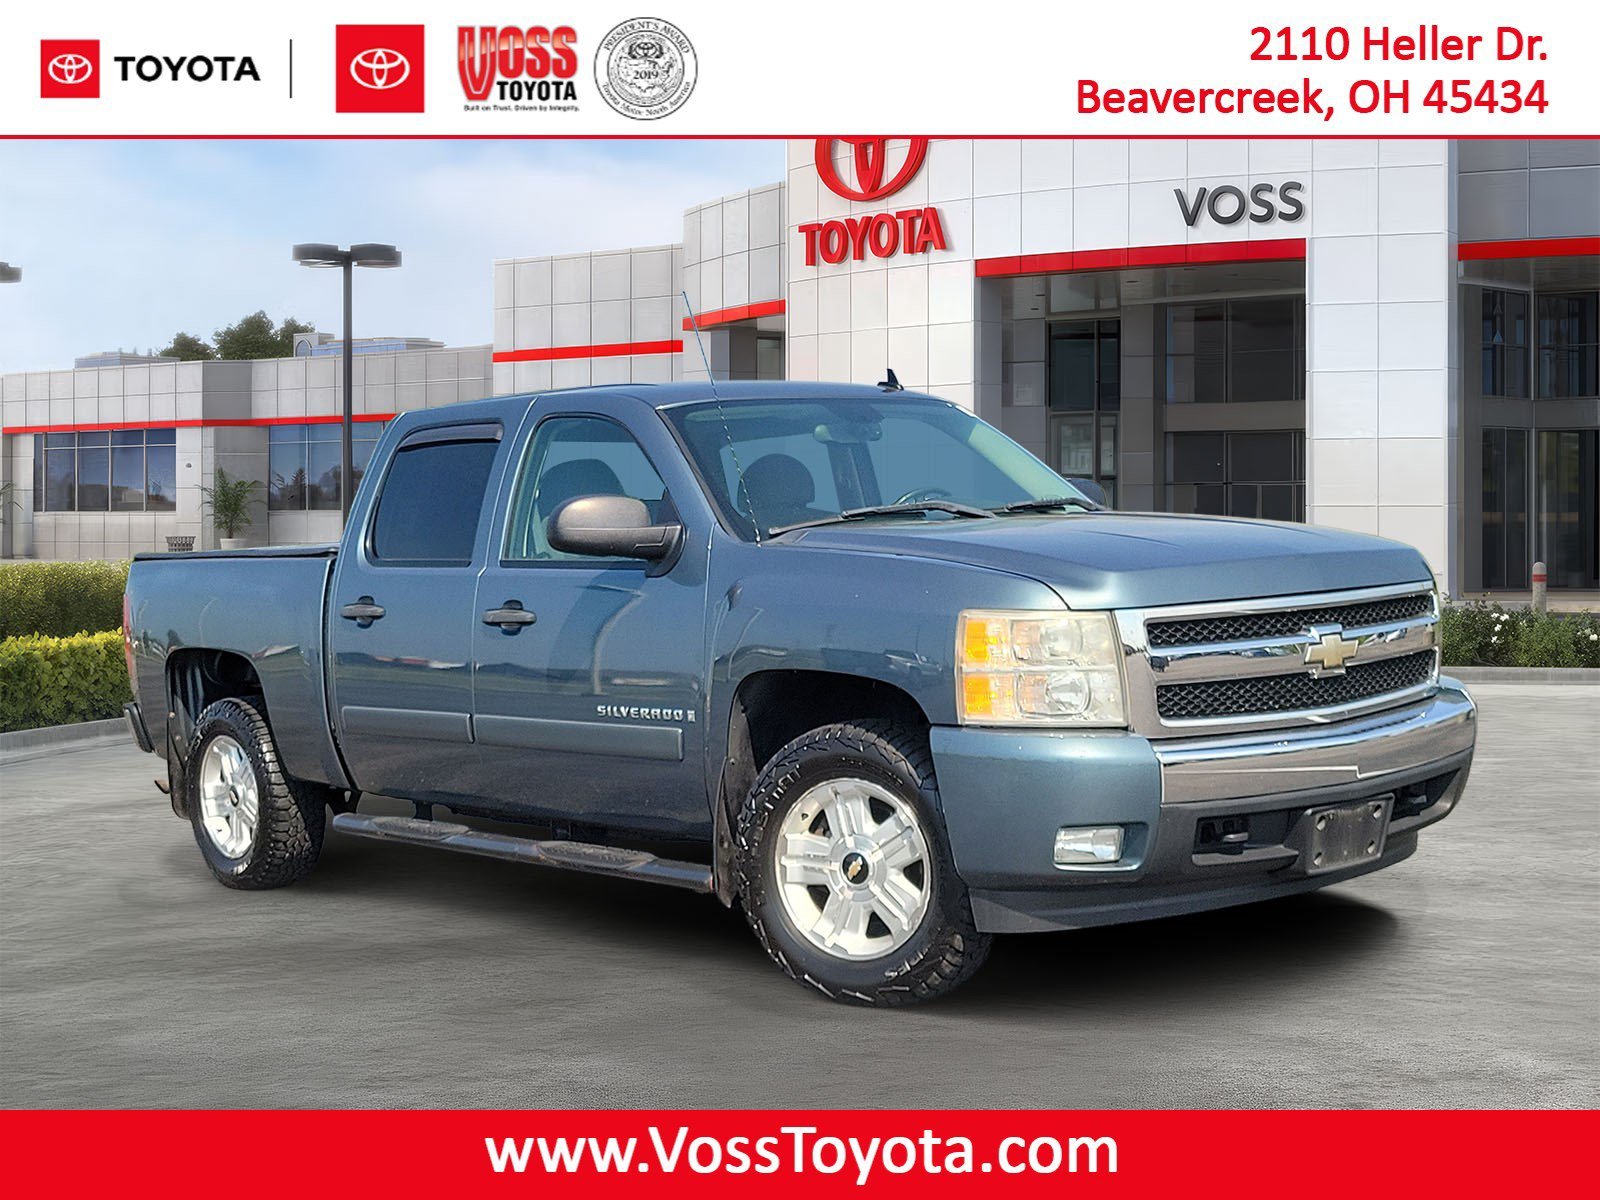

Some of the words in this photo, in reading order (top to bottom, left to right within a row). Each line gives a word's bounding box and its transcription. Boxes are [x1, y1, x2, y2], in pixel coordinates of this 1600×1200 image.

[1174, 181, 1305, 227] VOSS
[798, 207, 947, 267] TOYOTA
[597, 704, 684, 721] SILVERADO
